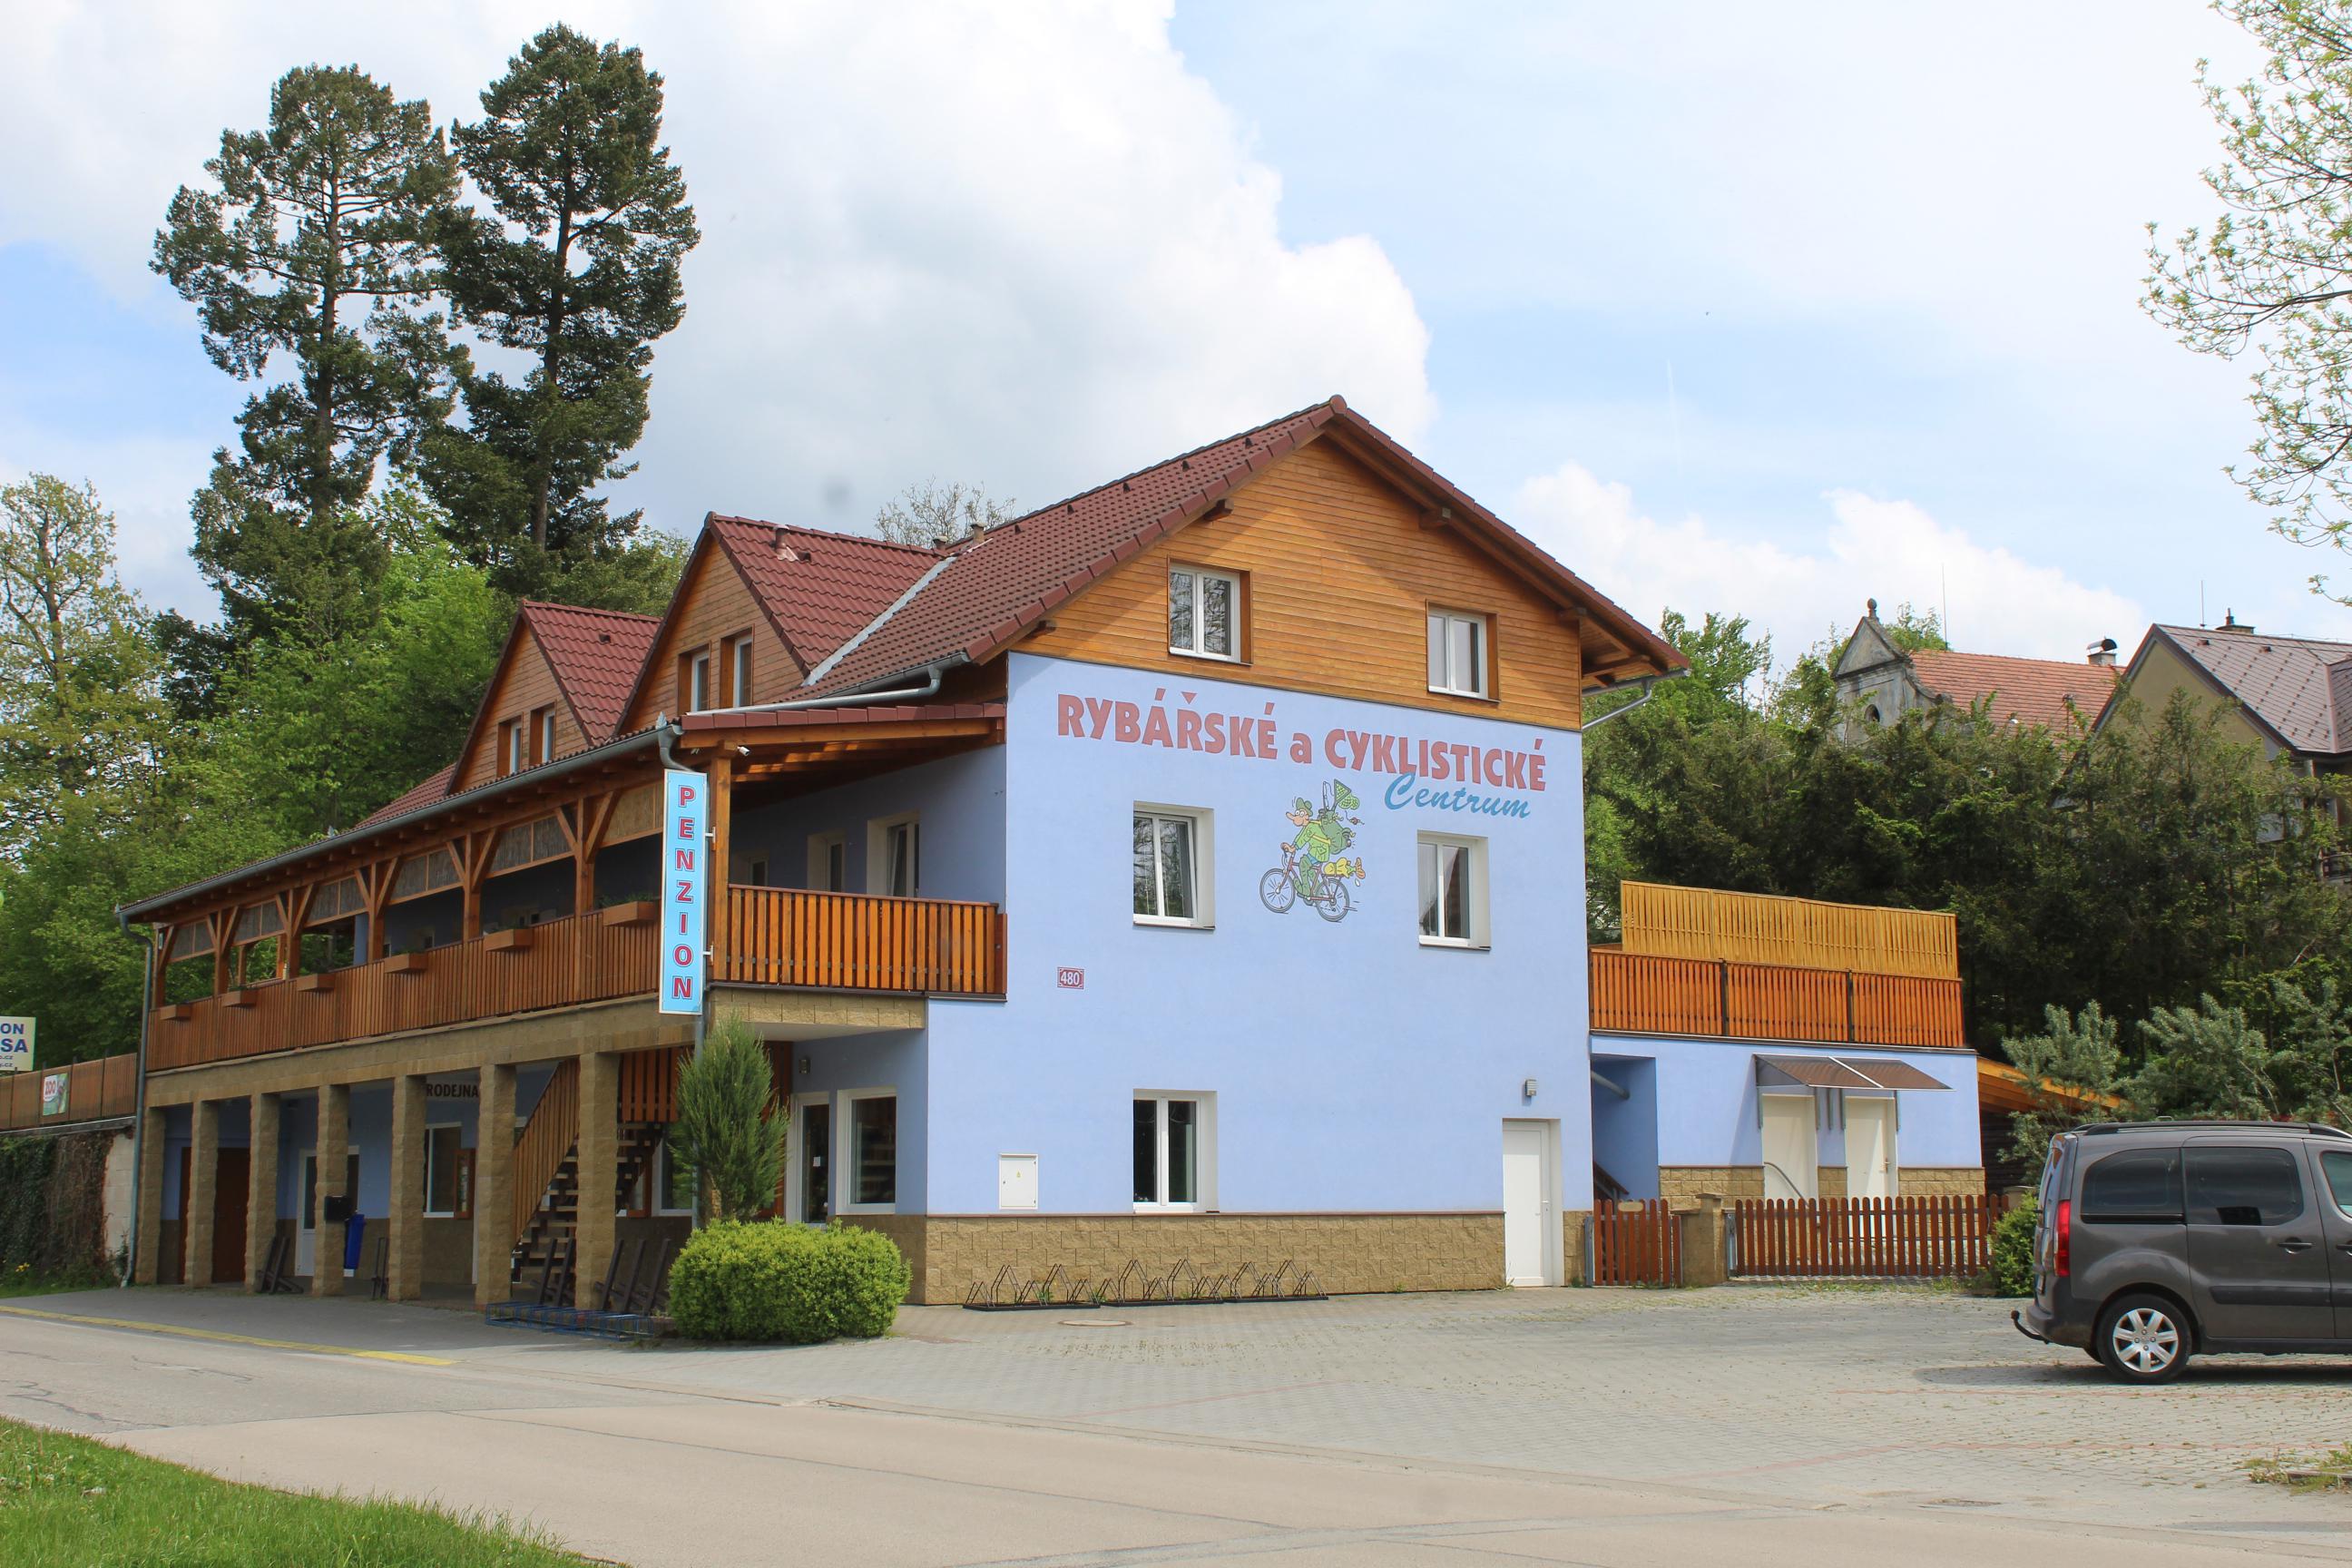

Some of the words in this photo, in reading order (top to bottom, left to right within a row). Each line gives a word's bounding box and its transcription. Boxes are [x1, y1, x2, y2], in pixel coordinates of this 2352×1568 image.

[1057, 688, 1279, 760] RYBÁŘSKÉ
[1289, 732, 1313, 764] a
[1324, 728, 1546, 792] CYKLISTICKÉ
[1384, 772, 1531, 818] Centrum
[672, 784, 696, 999] PENZION
[1060, 971, 1080, 985] 480
